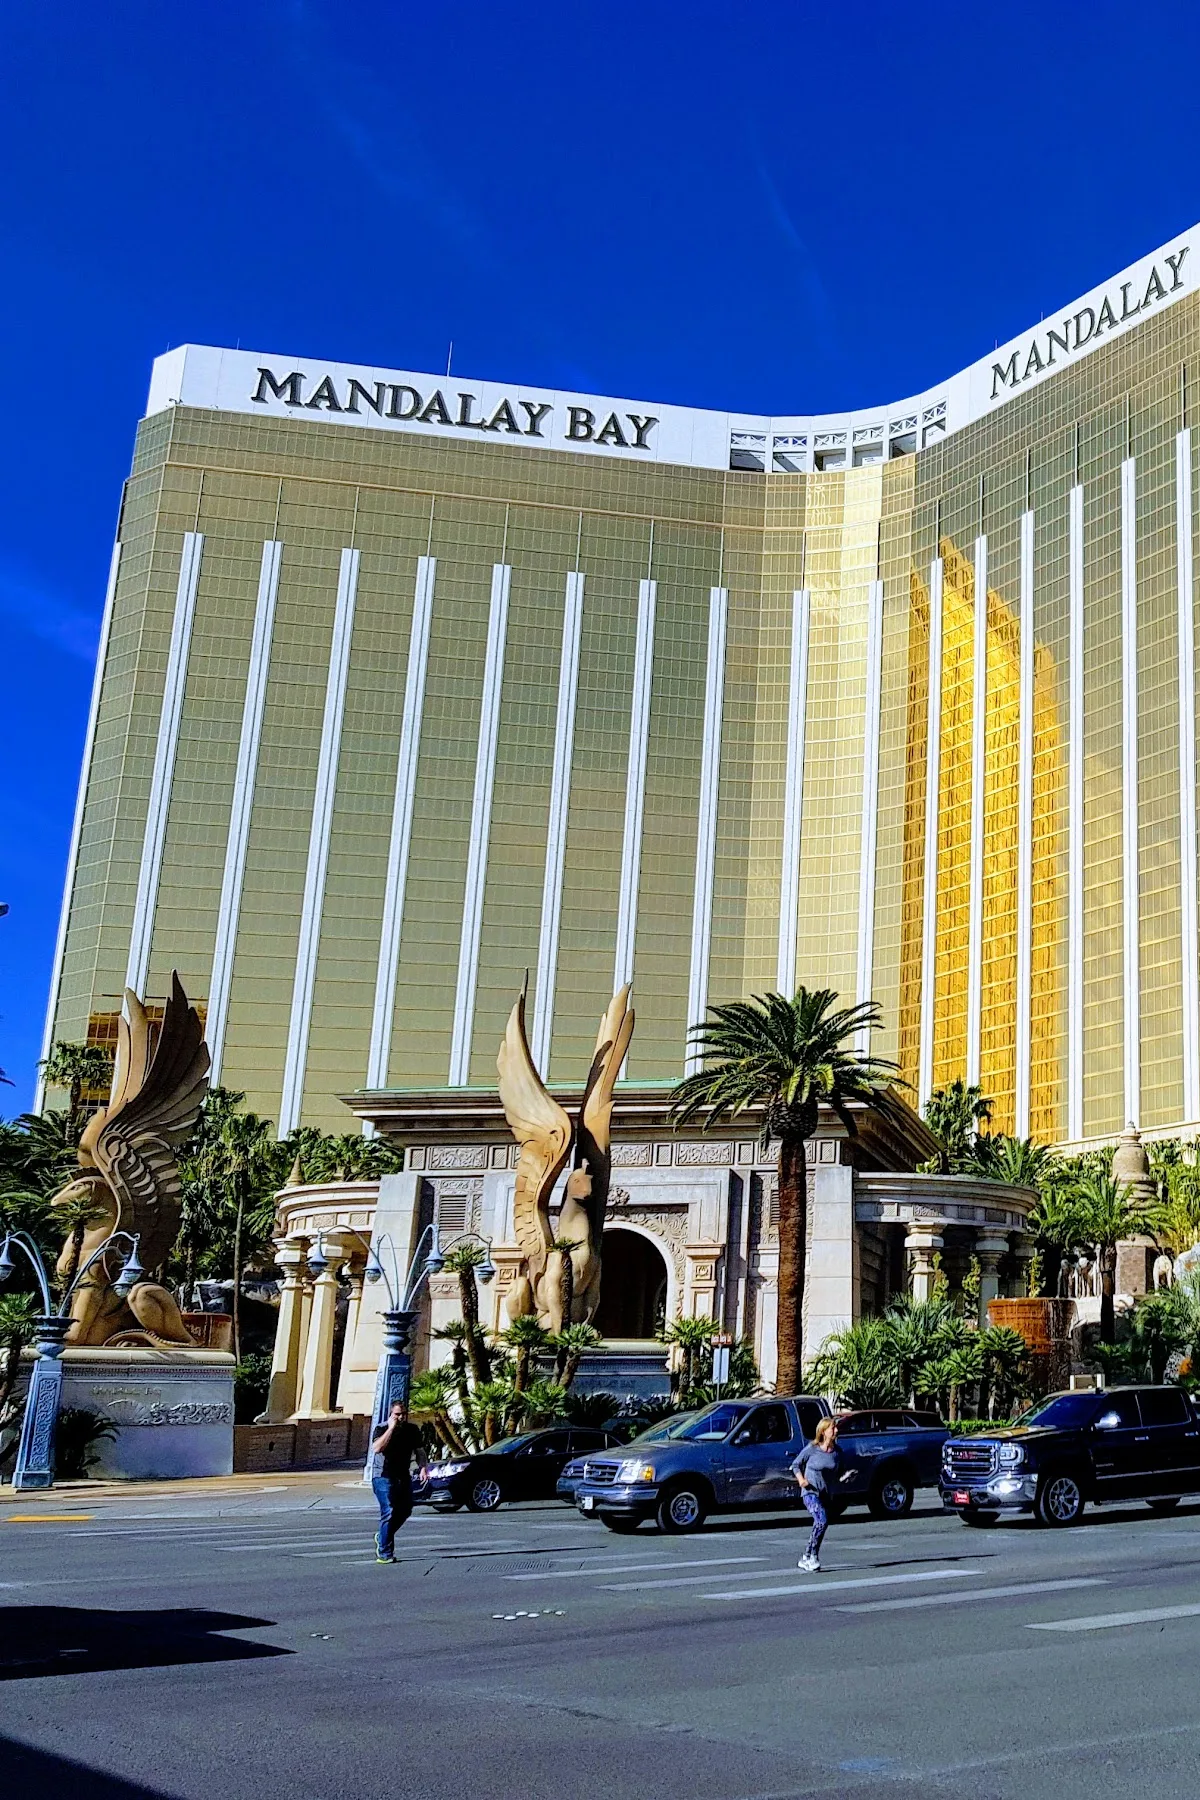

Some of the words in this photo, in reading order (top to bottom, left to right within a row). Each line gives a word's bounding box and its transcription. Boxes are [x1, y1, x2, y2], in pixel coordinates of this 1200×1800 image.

[990, 247, 1190, 400] MANDALAY
[251, 367, 554, 438] MANDALAY
[564, 406, 660, 450] BAY
